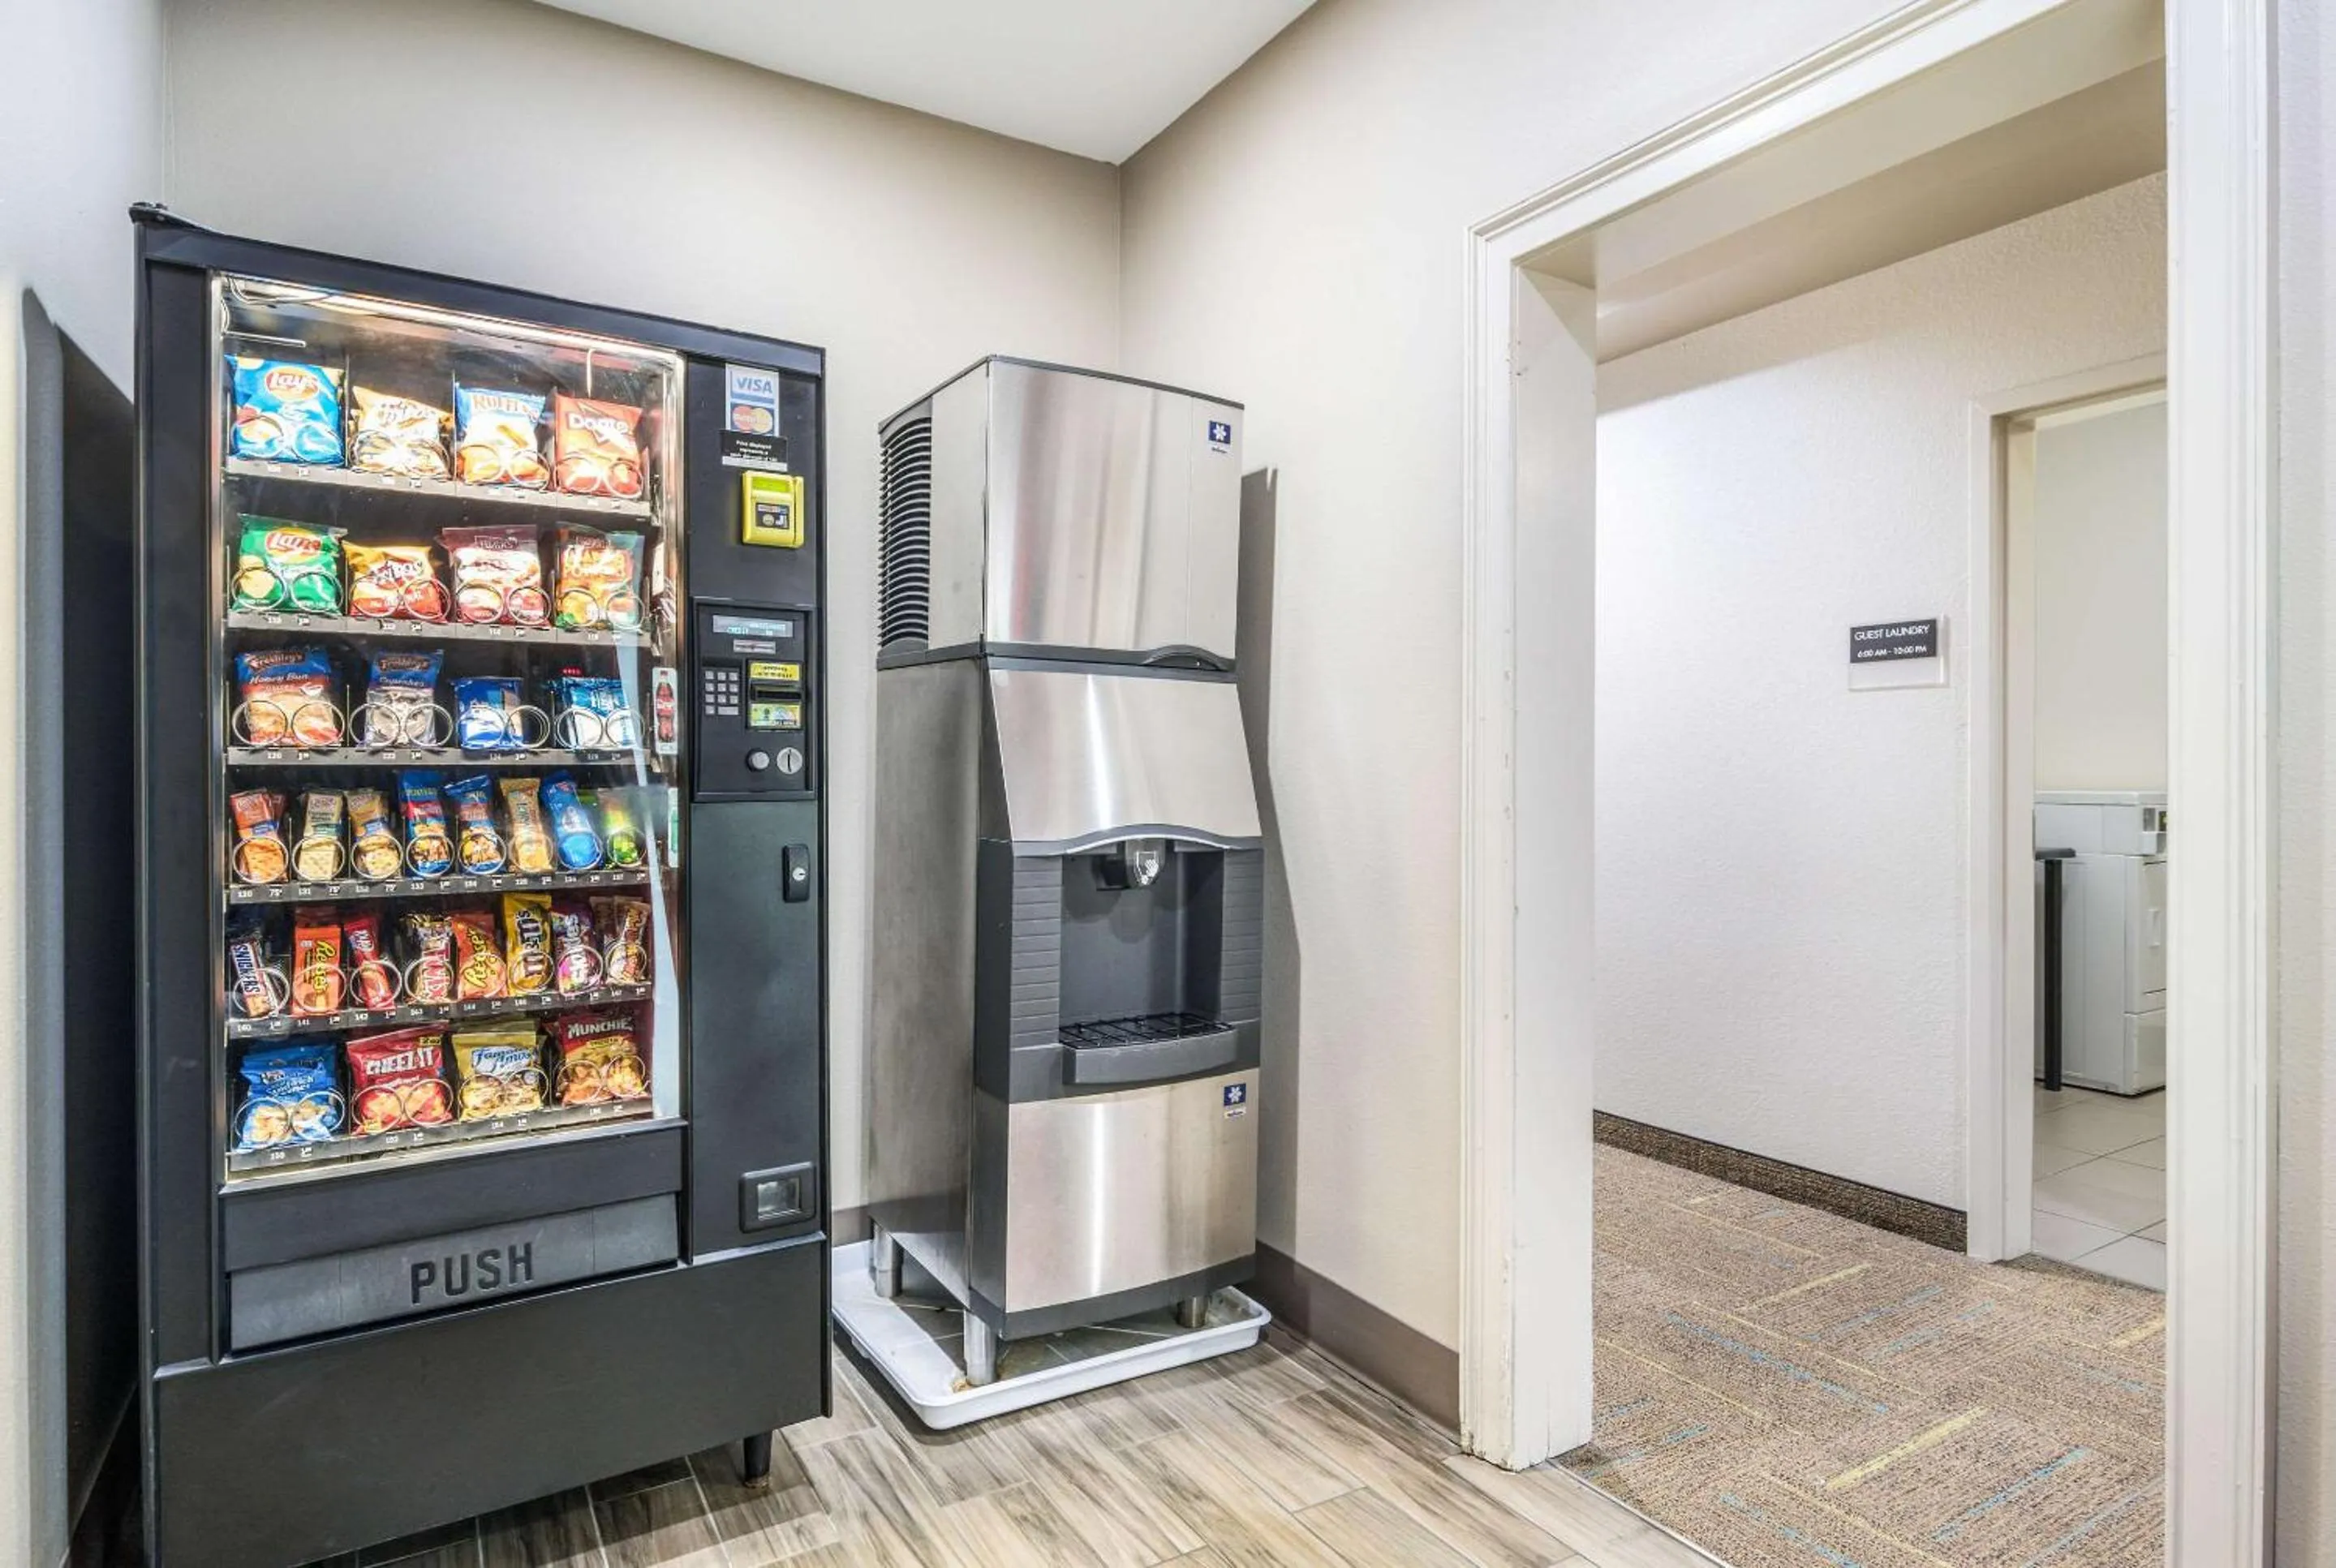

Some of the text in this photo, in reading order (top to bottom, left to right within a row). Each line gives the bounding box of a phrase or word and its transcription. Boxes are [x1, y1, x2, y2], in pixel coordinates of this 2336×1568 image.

[737, 376, 773, 393] VISA
[1854, 624, 1930, 641] GUEST LAUNDRY
[1856, 648, 1874, 658] 6:00
[1874, 648, 1887, 656] AM
[286, 672, 309, 681] Bun
[568, 1017, 633, 1039] MUNCHIE
[411, 1242, 533, 1304] PUSH
